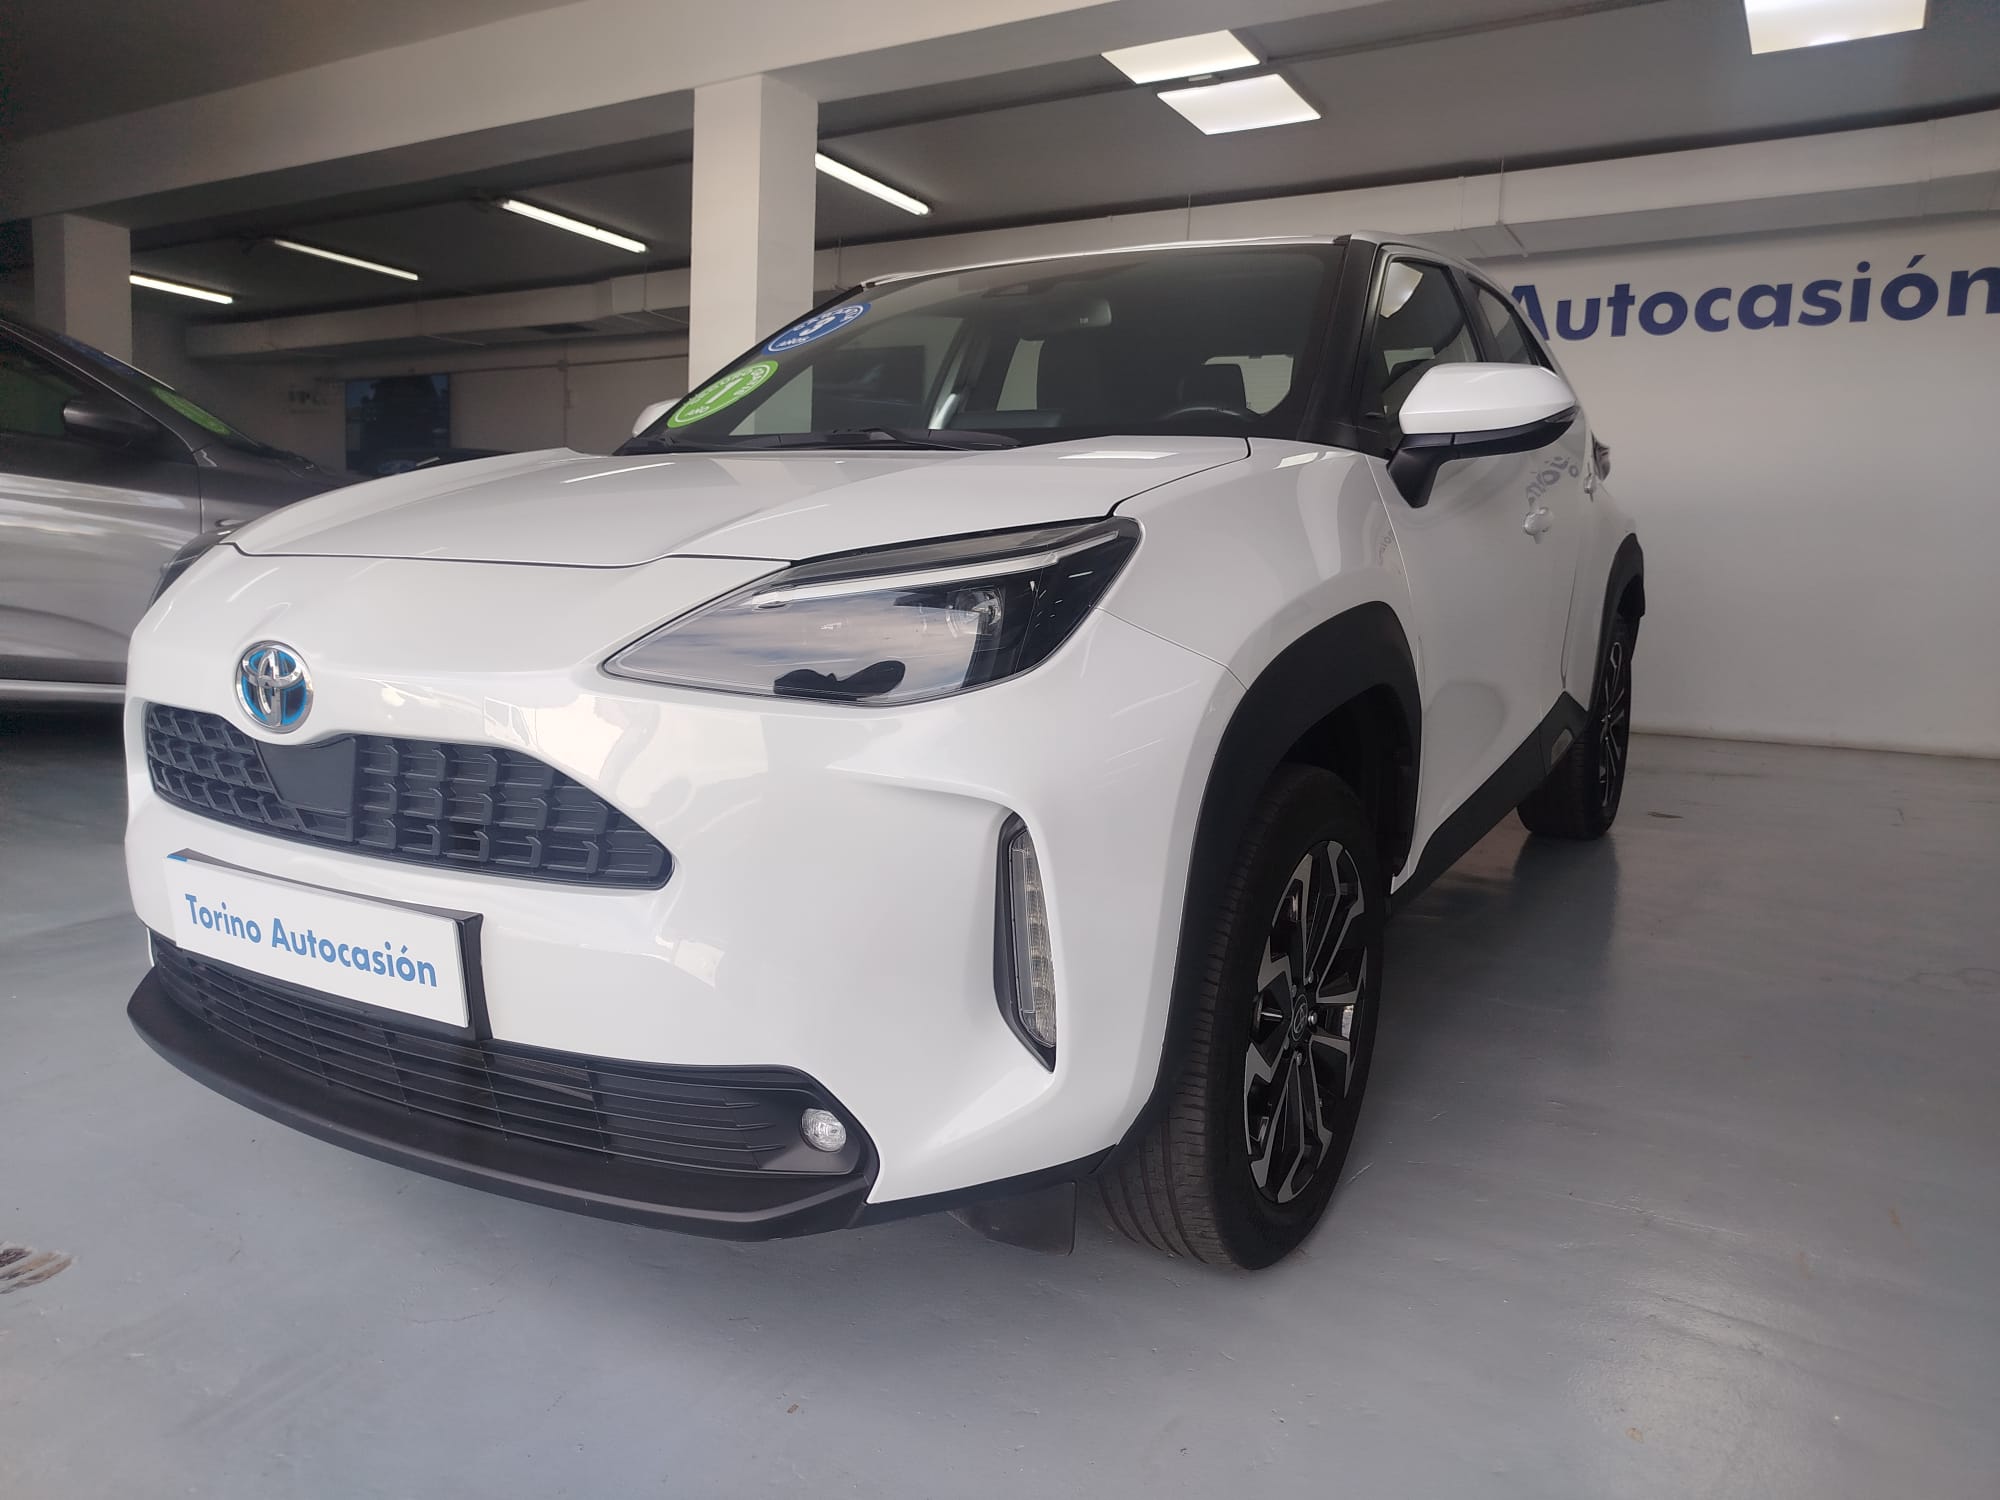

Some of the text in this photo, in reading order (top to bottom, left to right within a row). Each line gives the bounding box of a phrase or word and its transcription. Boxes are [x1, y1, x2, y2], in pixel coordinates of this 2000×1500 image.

[1511, 254, 2000, 341] Autocasión
[185, 893, 437, 987] Torino Autocasión
